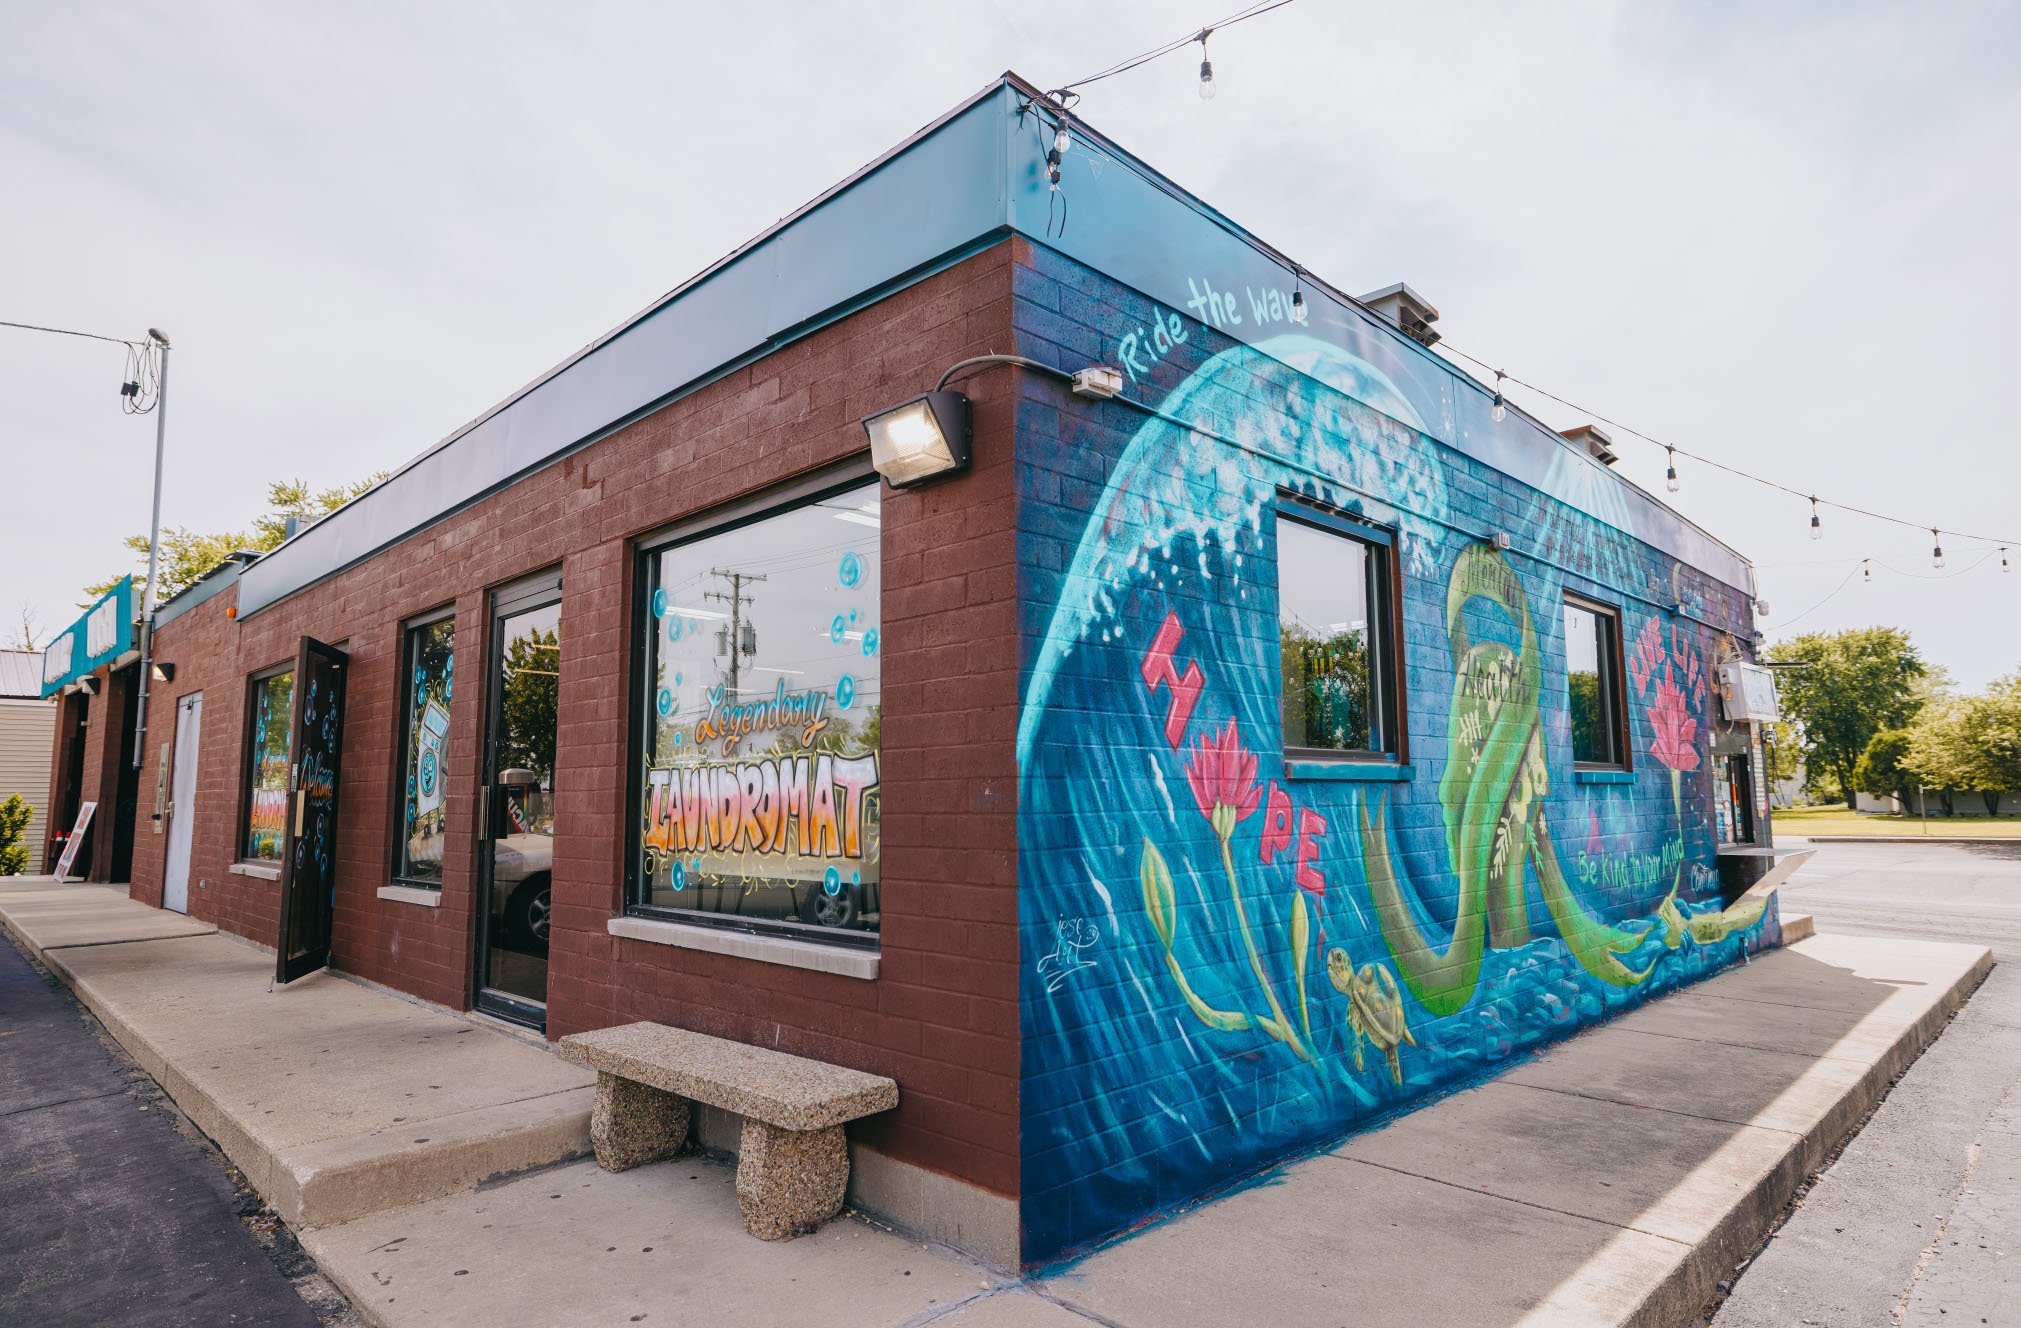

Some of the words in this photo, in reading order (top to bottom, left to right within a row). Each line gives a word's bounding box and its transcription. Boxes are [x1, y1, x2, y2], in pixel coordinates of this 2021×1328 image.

[1118, 306, 1188, 383] Ride
[1187, 277, 1242, 332] the
[695, 677, 829, 756] Legendary
[646, 751, 880, 858] LAUNDROMAT
[1578, 850, 1598, 885] Be
[1629, 840, 1642, 882] to
[1641, 853, 1661, 891] your
